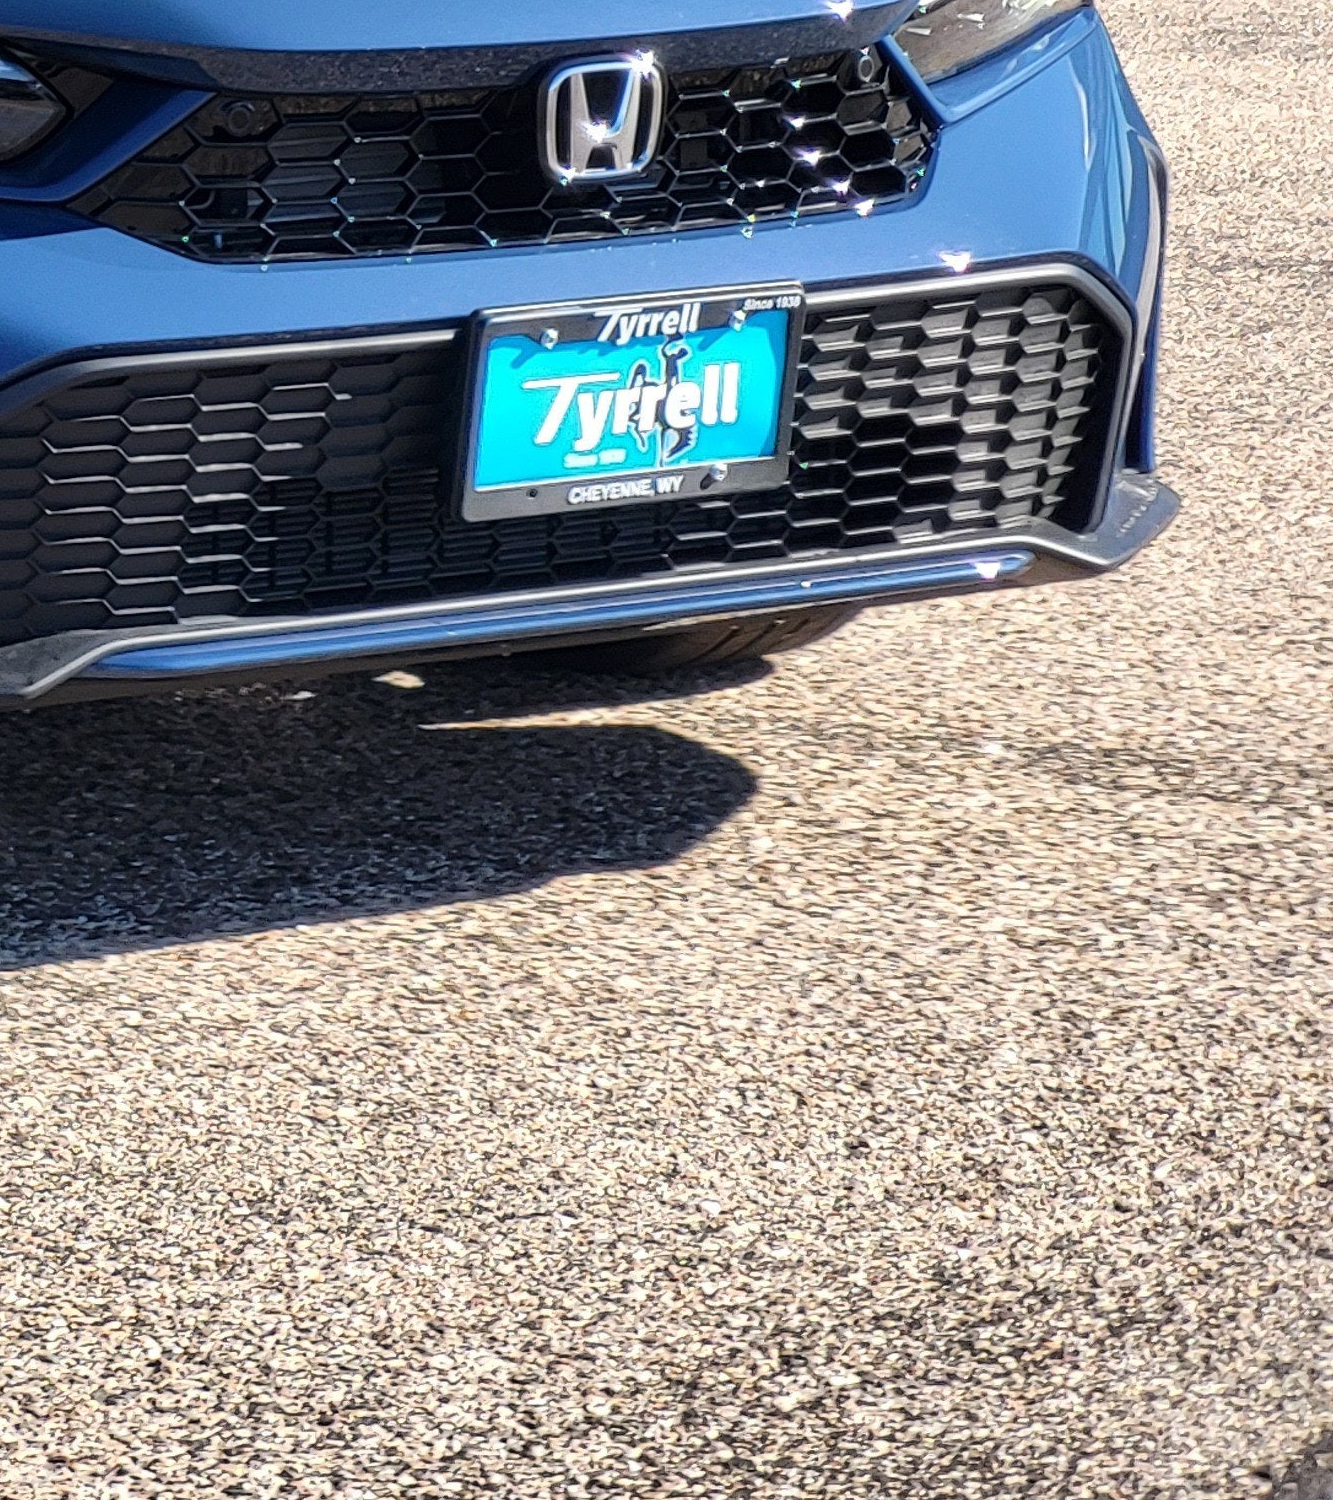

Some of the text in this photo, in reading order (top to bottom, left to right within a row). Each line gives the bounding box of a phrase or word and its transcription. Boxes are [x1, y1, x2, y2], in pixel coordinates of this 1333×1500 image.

[593, 302, 702, 345] Tyrrell
[521, 361, 741, 452] Tyrrell
[656, 475, 684, 494] WY
